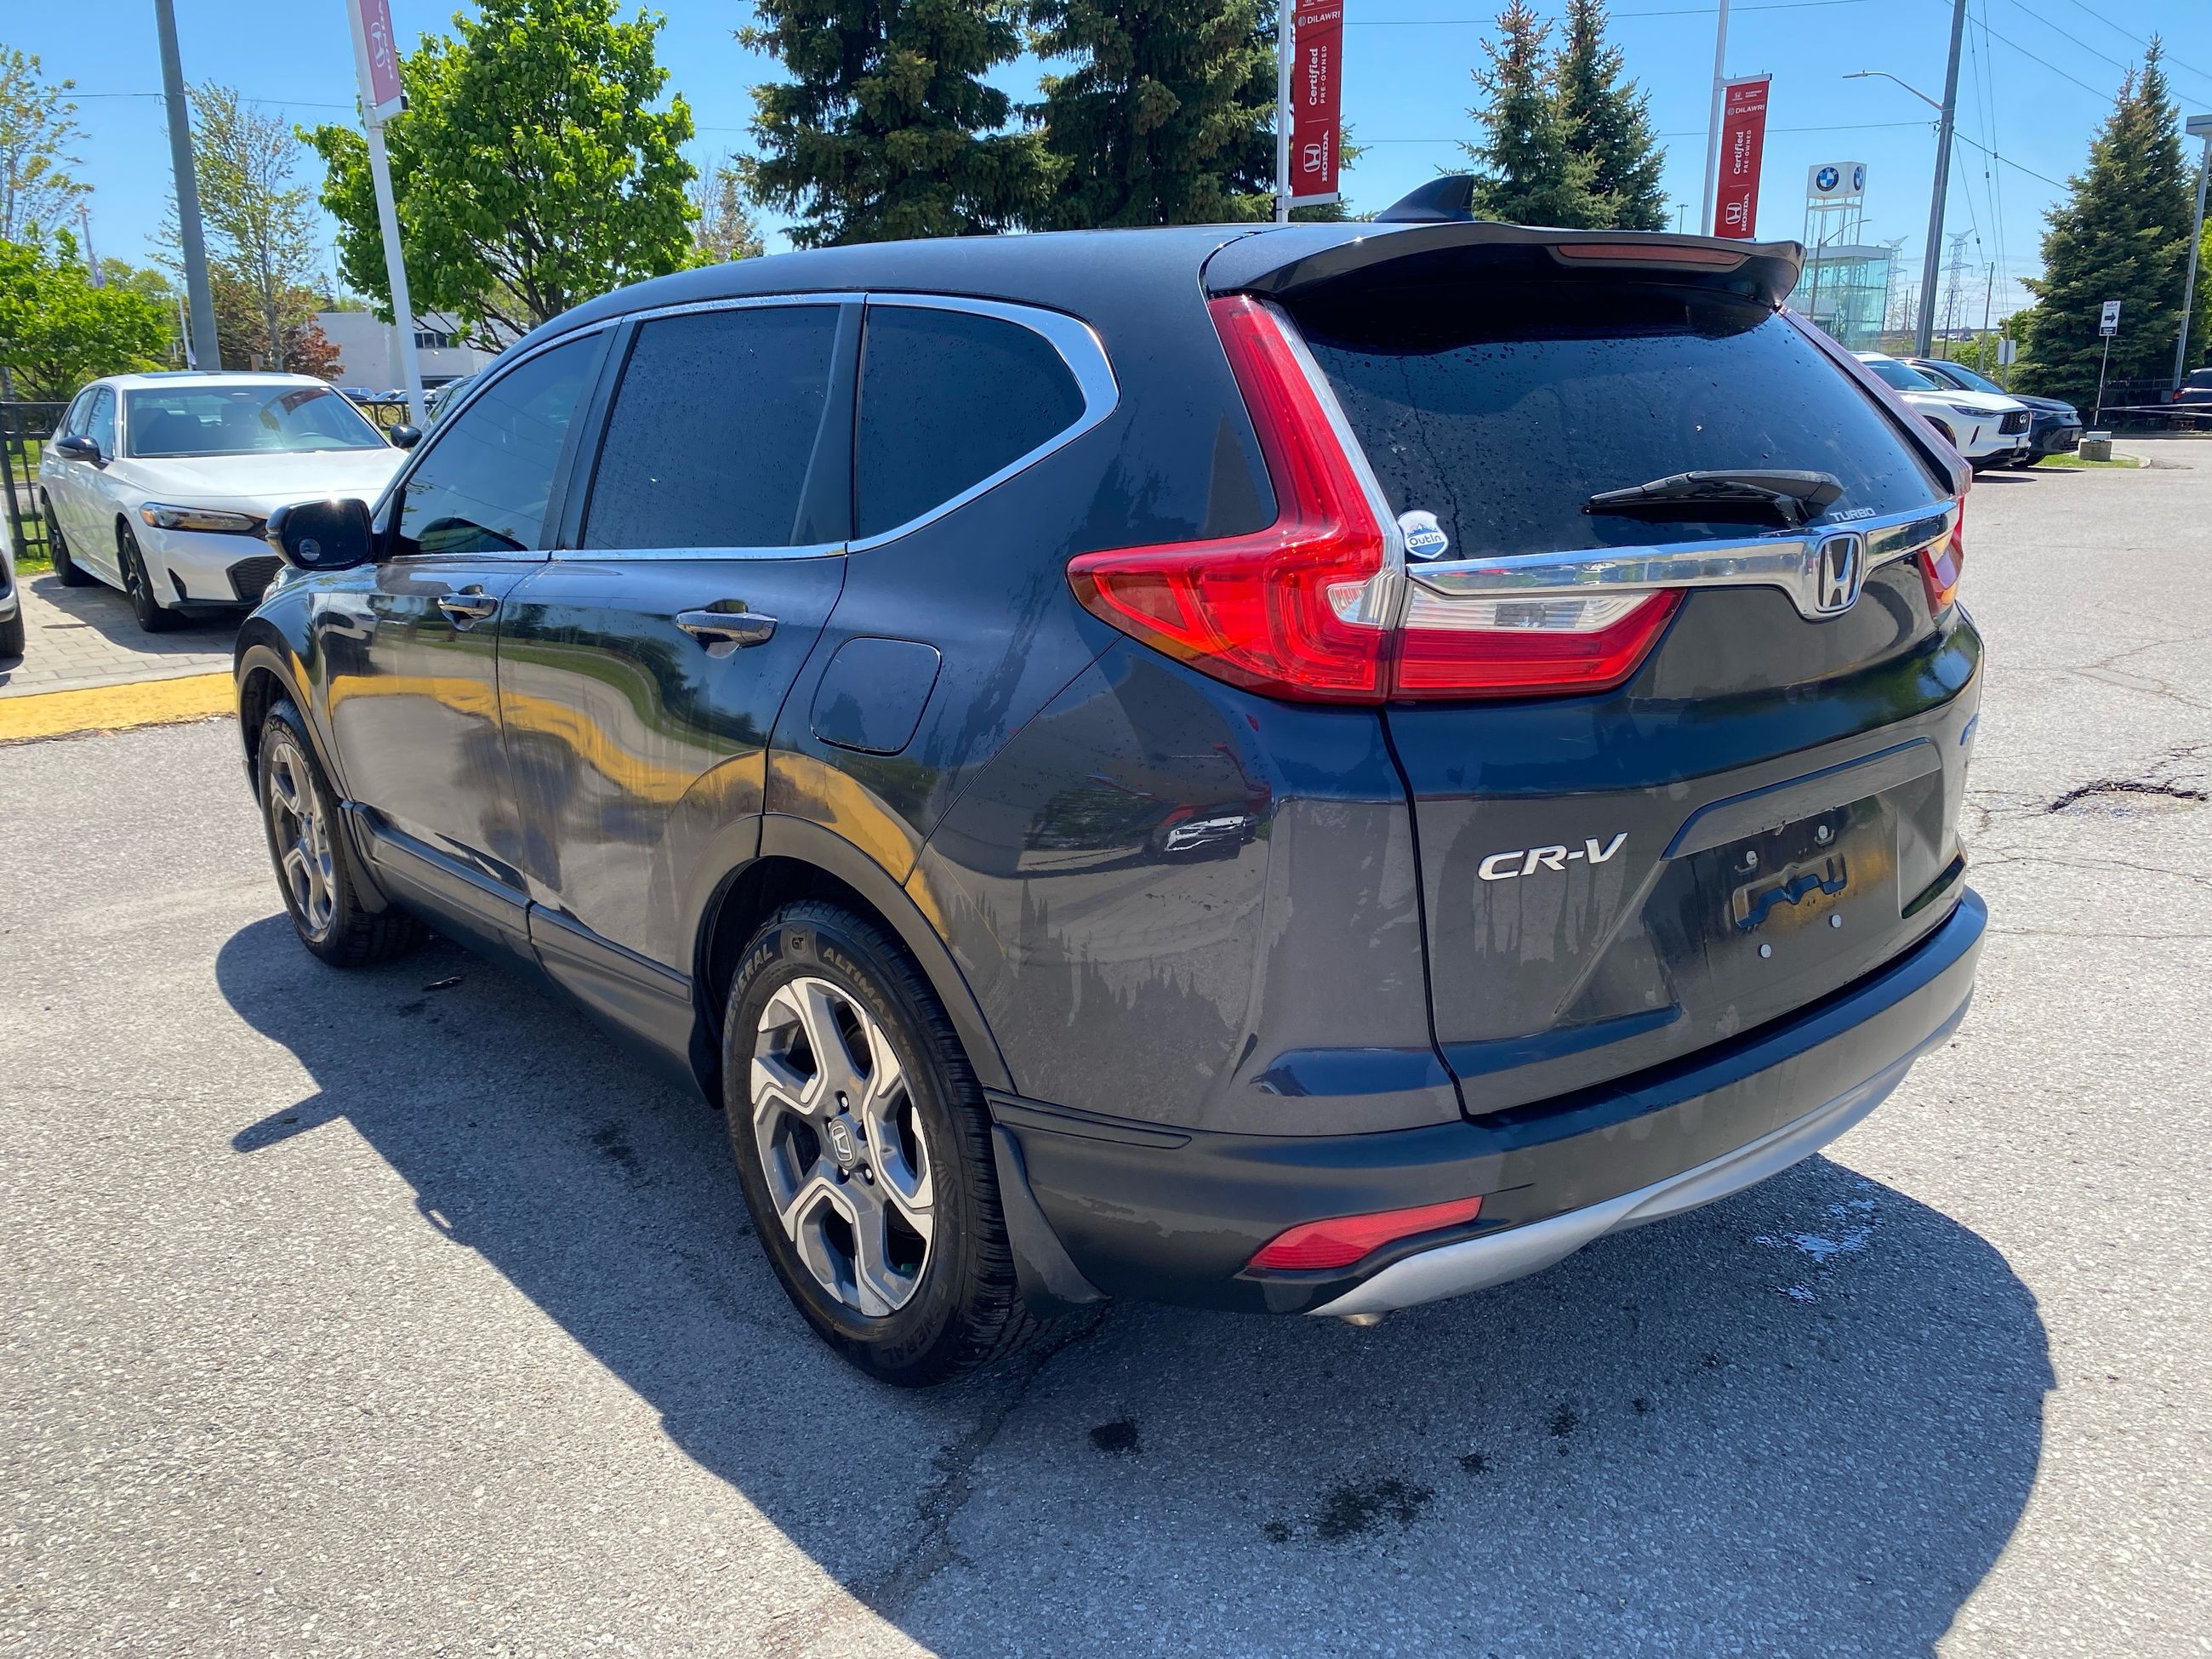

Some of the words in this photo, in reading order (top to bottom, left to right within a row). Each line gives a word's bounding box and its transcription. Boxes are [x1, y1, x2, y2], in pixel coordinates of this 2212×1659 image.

[1307, 10, 1341, 25] DILAWRI
[1309, 48, 1319, 106] Certified
[1736, 104, 1765, 115] DILAWRI
[1733, 131, 1744, 175] Certified
[1743, 129, 1752, 174] PRE-OWNED
[1741, 192, 1750, 232] HONDA
[1829, 508, 1876, 522] TURBO
[1478, 831, 1628, 881] CR-V
[823, 947, 898, 1031] ALTIMAX
